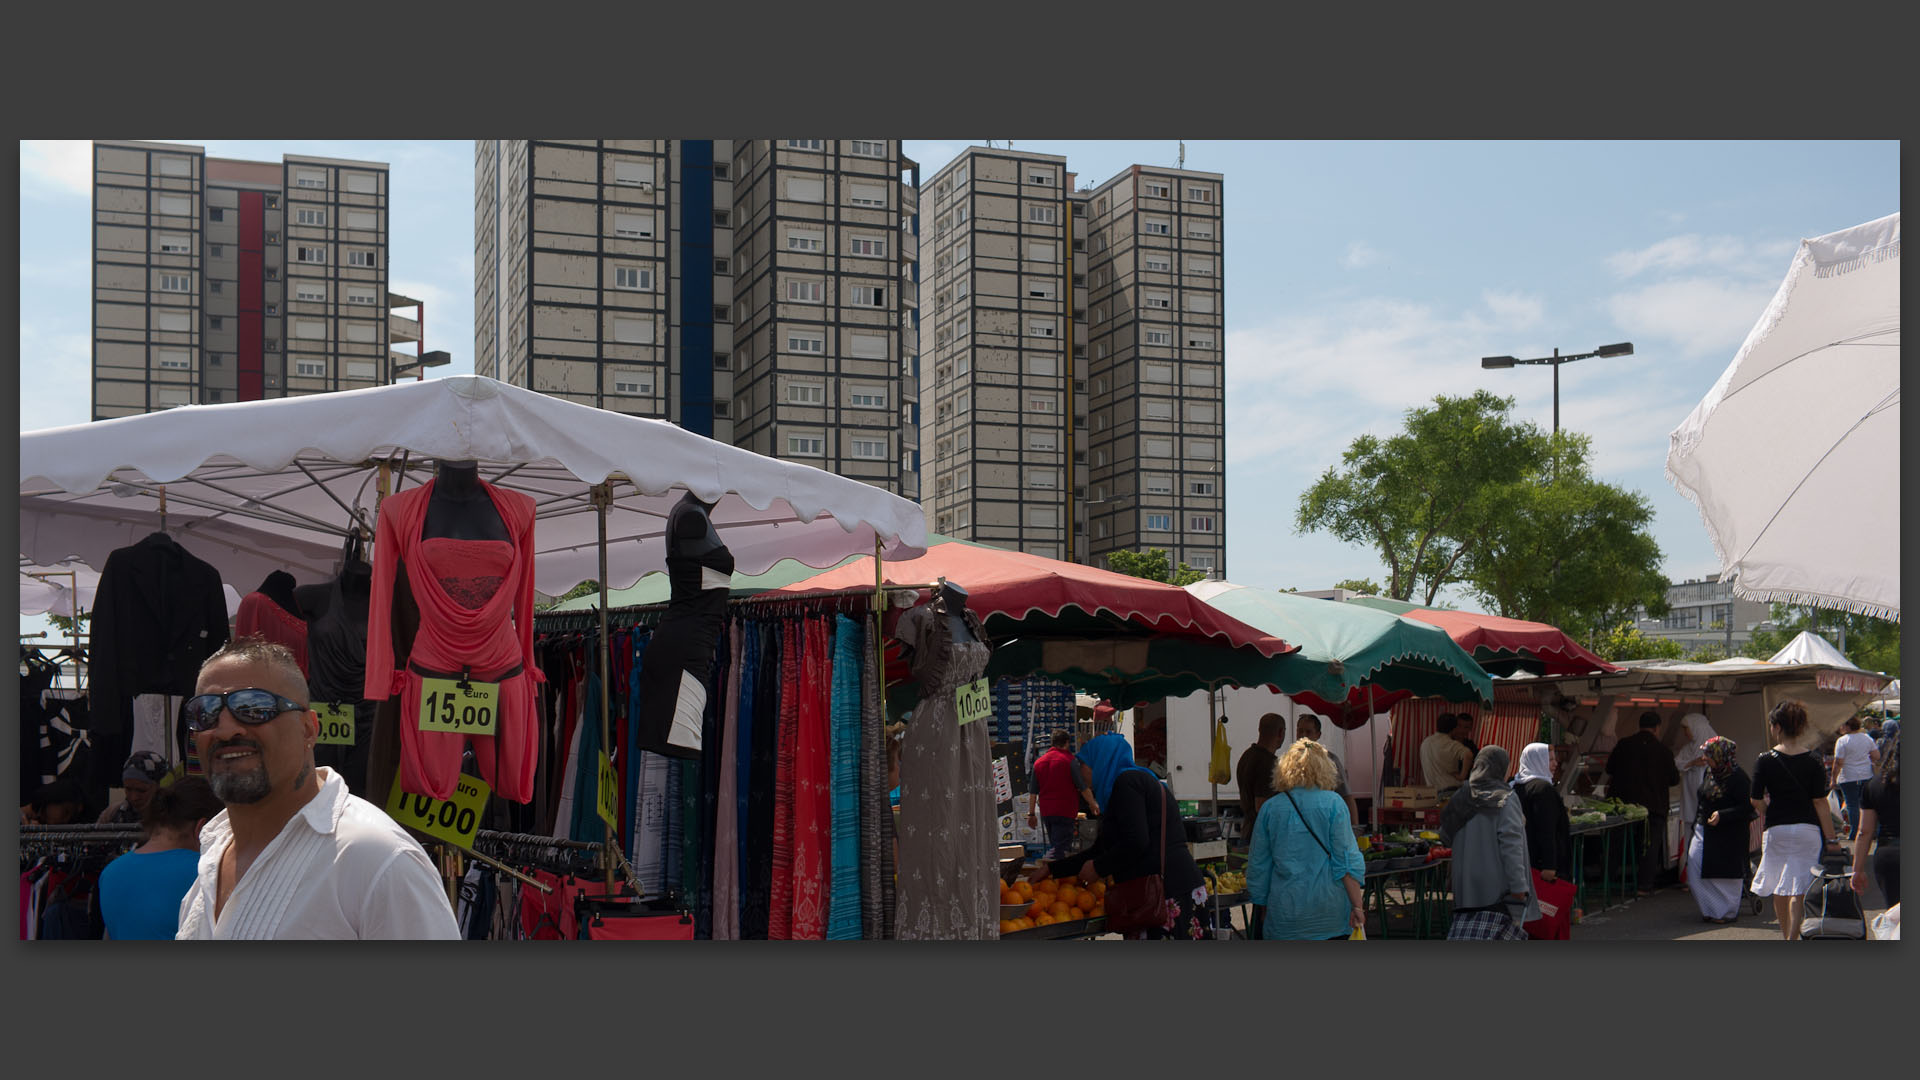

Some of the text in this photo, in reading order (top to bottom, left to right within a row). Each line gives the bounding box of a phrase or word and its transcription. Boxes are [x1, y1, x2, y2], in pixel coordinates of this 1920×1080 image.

[426, 691, 491, 728] 15,00
[959, 693, 989, 718] 10,00
[457, 782, 478, 797] uro
